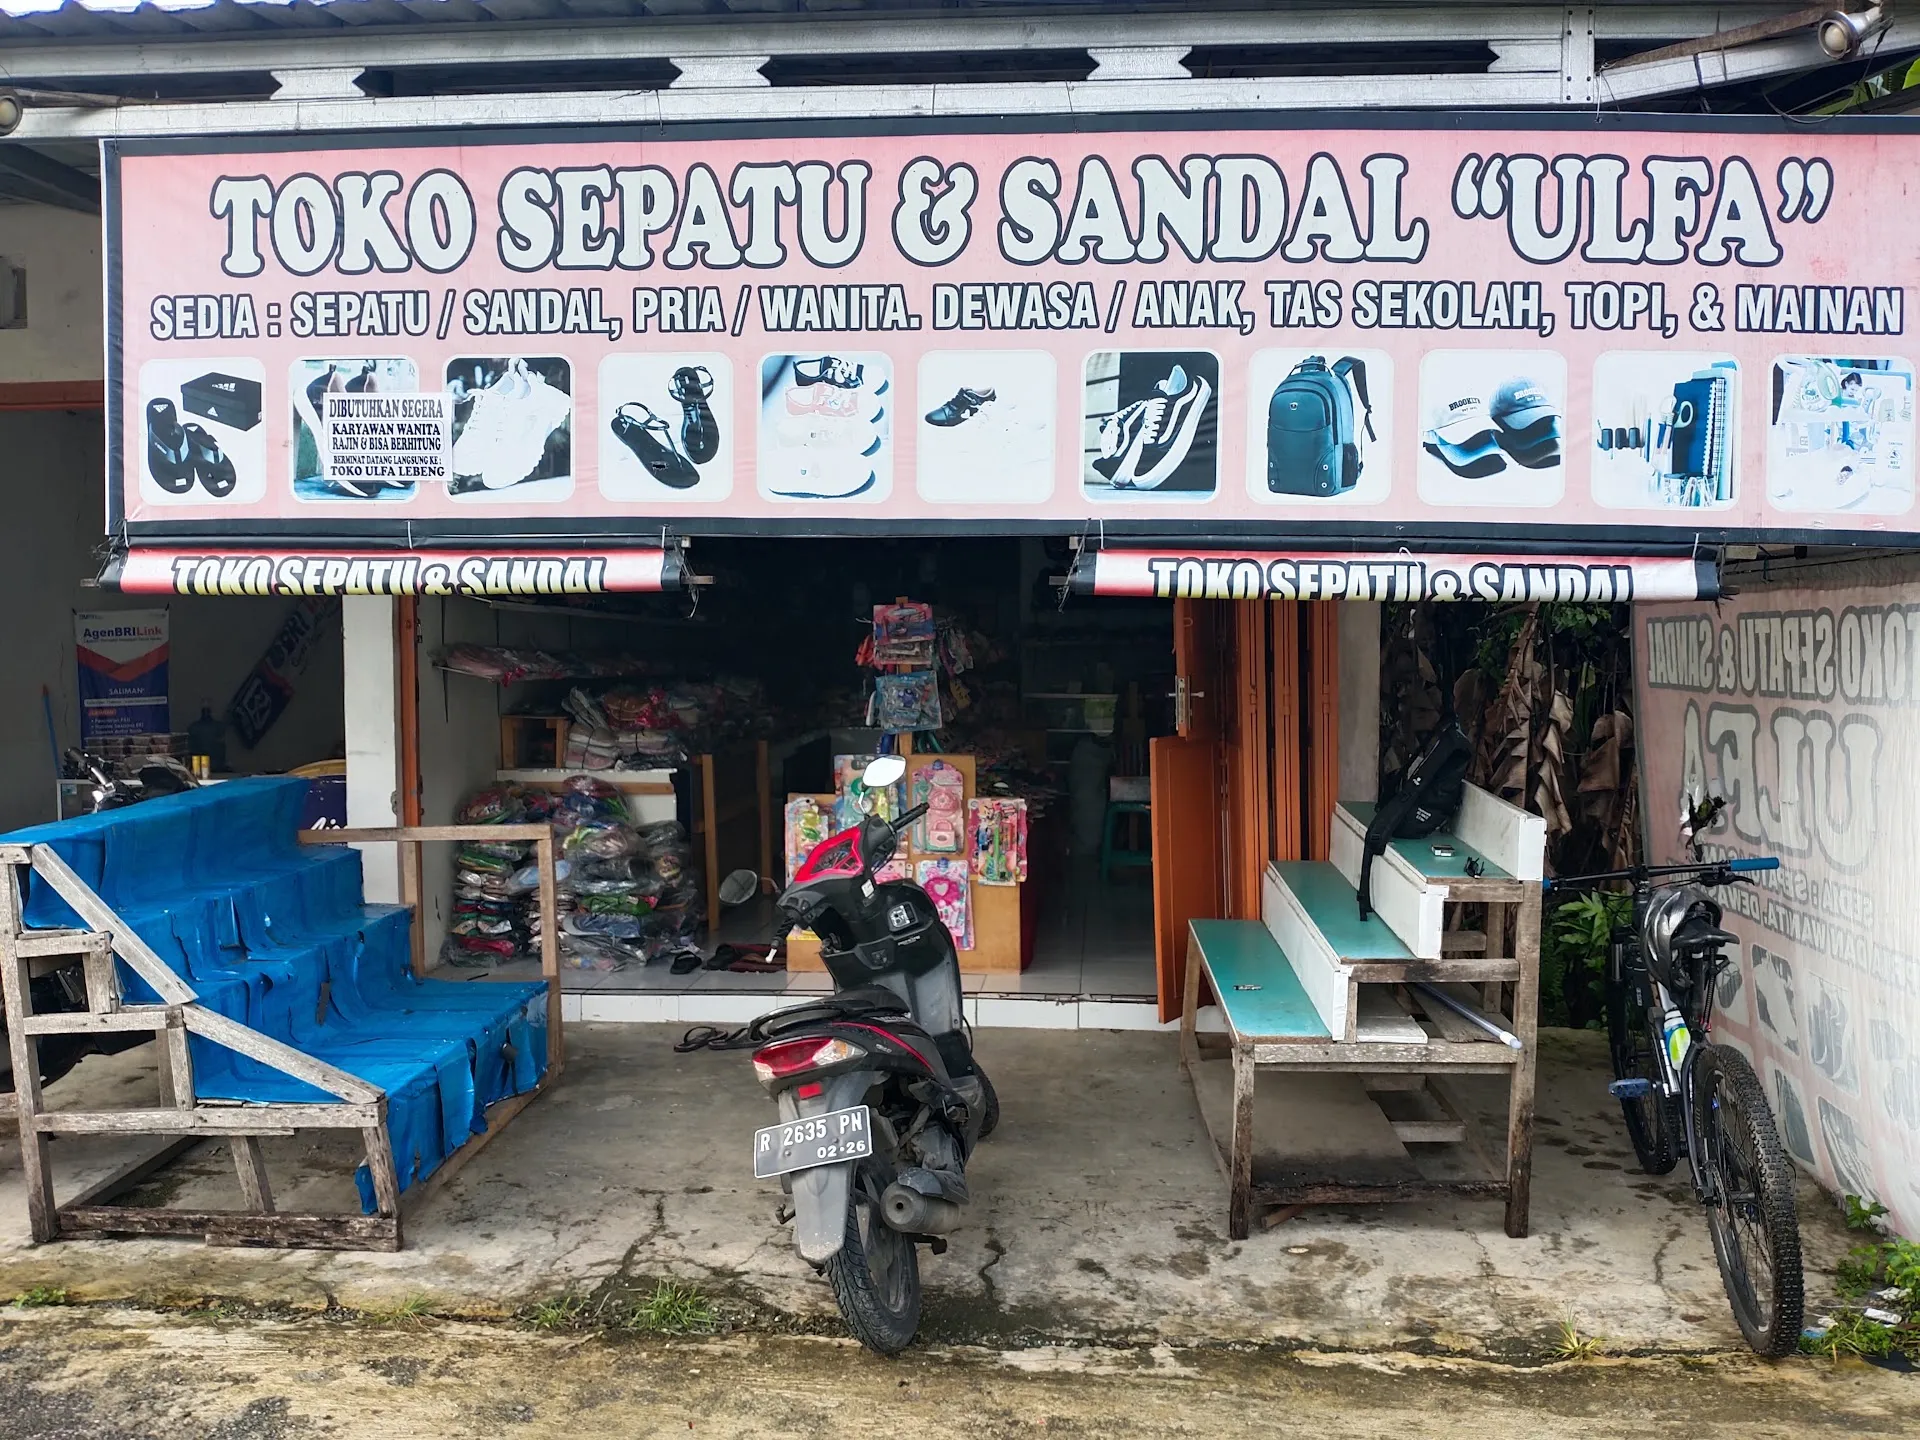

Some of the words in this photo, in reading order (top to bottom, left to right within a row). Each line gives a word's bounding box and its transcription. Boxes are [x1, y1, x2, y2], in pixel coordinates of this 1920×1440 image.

[211, 170, 477, 278] TOKO
[497, 159, 874, 274] SEPATU
[891, 155, 978, 271] &
[999, 152, 1430, 266] SANDAL
[150, 293, 258, 341] SEDIA
[289, 290, 429, 339] SEPATU
[437, 288, 457, 339] /
[463, 287, 623, 341] SANDAL,
[632, 286, 723, 334] PRIA
[730, 285, 751, 337] /
[759, 285, 922, 333] WANITA.
[932, 281, 1099, 332] DEWASA
[1104, 281, 1127, 334] /
[1134, 281, 1256, 336] ANAK,
[1265, 280, 1343, 329] TAS
[1351, 280, 1556, 337] SEKOLAH,
[1565, 280, 1679, 339] TOPI,
[1688, 283, 1724, 331] &
[1734, 284, 1905, 336] MAINAN
[329, 399, 400, 418] DIBUTUHKAN
[402, 399, 443, 418] SEGERA
[333, 423, 394, 435] KARYAWAN
[397, 424, 440, 435] WANITA
[333, 437, 358, 450] RAJIN
[361, 437, 367, 449] &
[370, 437, 389, 450] BISA
[391, 437, 441, 451] BERHITUNG
[334, 456, 365, 464] BERMINAT
[367, 456, 392, 464] DATANG
[394, 456, 428, 465] LANGSUNG
[331, 466, 362, 476] TOKO
[366, 466, 395, 476] ULFA
[399, 467, 445, 477] LEBENG
[170, 555, 276, 595] TOKO
[423, 563, 456, 595] &
[1148, 557, 1266, 599] TOKO
[1430, 569, 1467, 602] &
[83, 625, 163, 640] AgenBRILink
[760, 1133, 772, 1152] R
[783, 1118, 827, 1146] 2635
[839, 1111, 863, 1134] PN
